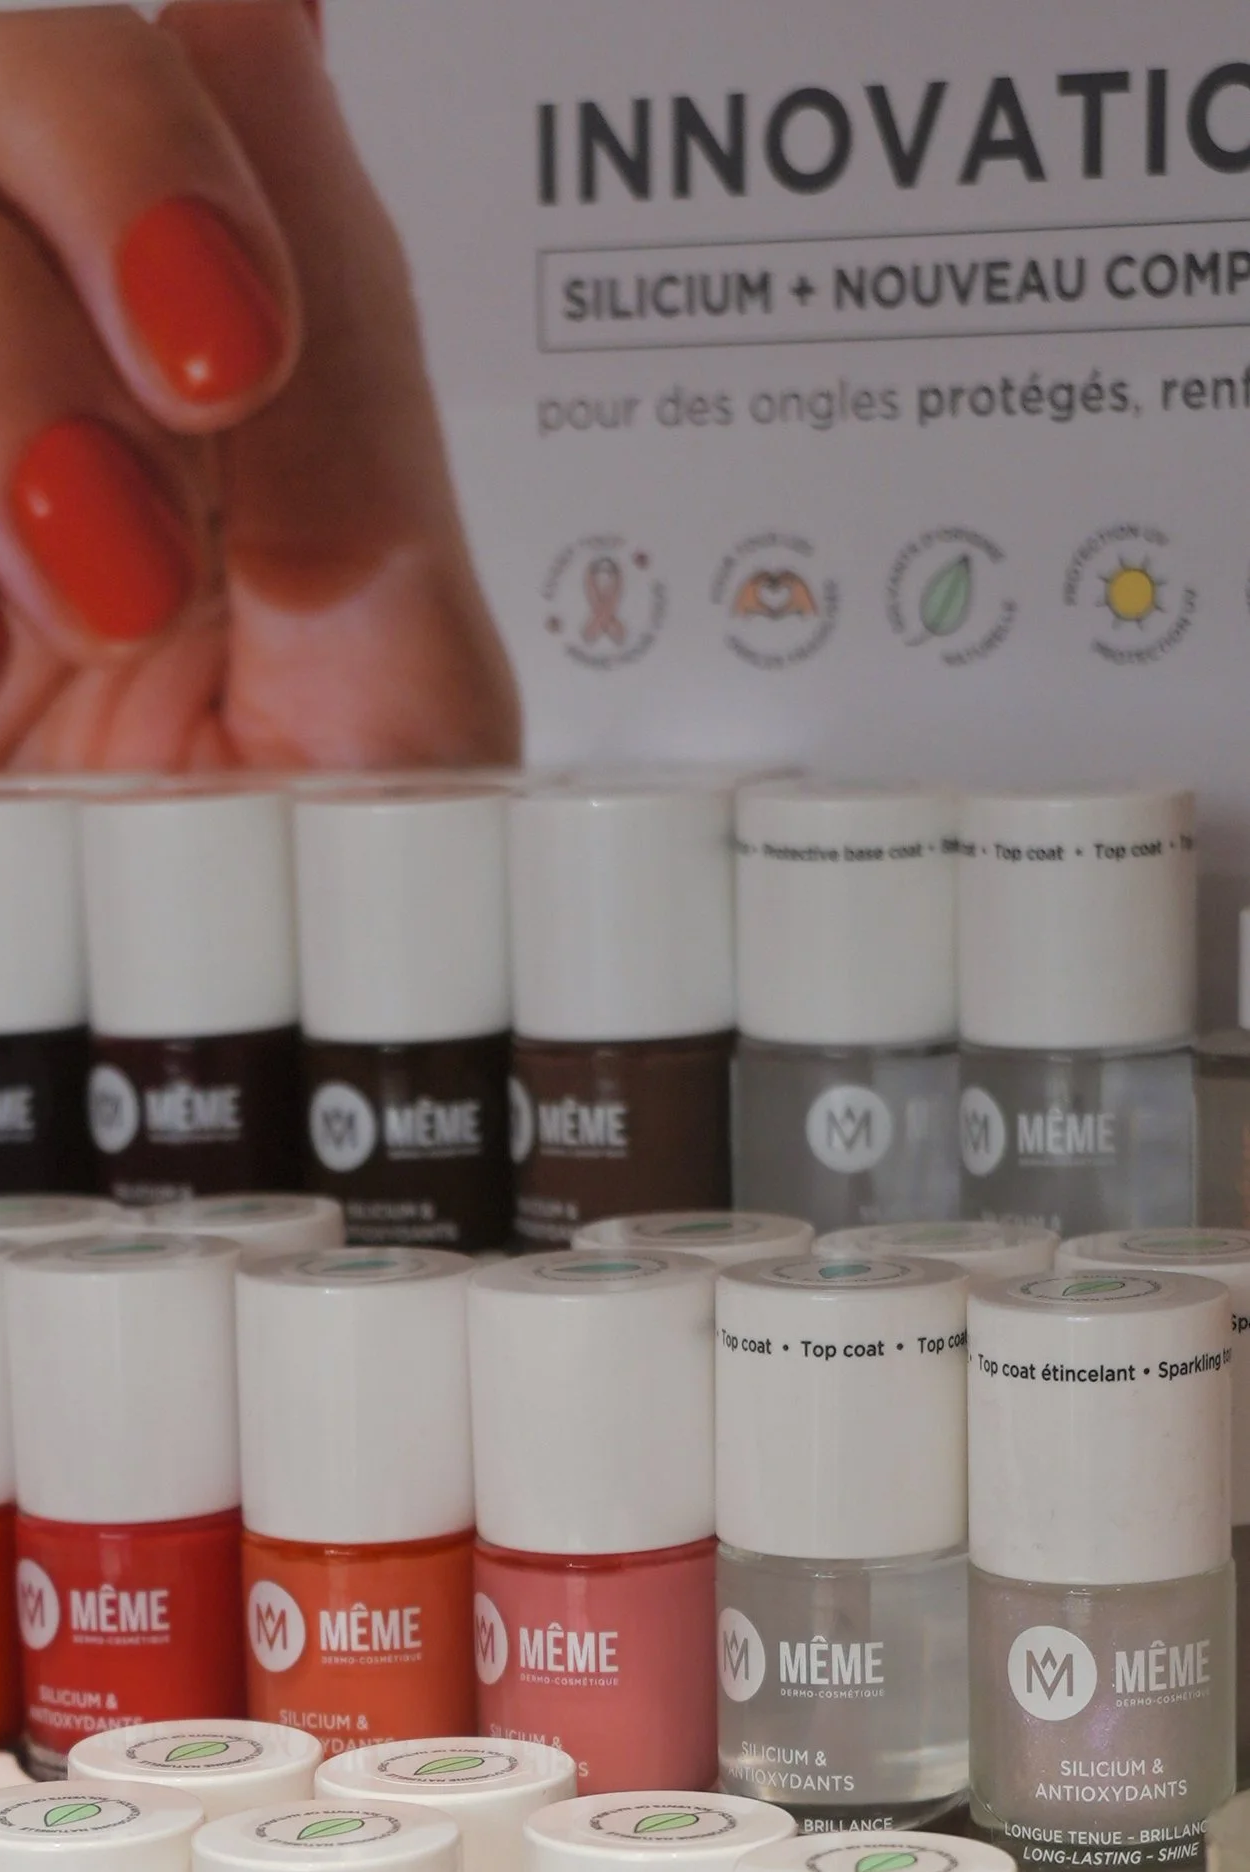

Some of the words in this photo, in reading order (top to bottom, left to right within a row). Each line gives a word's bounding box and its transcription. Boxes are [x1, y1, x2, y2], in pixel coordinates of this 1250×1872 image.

[537, 60, 1250, 206] INNOVATIO
[562, 270, 774, 323] SILICIUM
[832, 257, 1086, 311] NOUVEAU
[1105, 250, 1250, 300] COMP
[538, 392, 639, 438] pour
[656, 383, 734, 430] des
[751, 378, 901, 431] ongles
[917, 369, 1144, 427] protégés,
[844, 845, 885, 863] base
[889, 843, 924, 859] coat
[994, 844, 1022, 863] Top
[1027, 845, 1065, 862] coat
[1095, 843, 1126, 862] Top
[1131, 840, 1163, 858] coat
[1017, 1109, 1116, 1155] MÊME
[720, 1329, 739, 1353] Top
[741, 1336, 772, 1356] coat
[800, 1340, 837, 1361] Top
[843, 1339, 885, 1358] coat
[917, 1336, 945, 1357] Top
[978, 1353, 999, 1380] Top
[1001, 1361, 1036, 1380] coat
[1042, 1361, 1136, 1384] étincelant
[1158, 1351, 1222, 1381] Sparkling
[69, 1583, 171, 1633] MÊME
[319, 1602, 422, 1652] MÊME
[519, 1621, 619, 1674] MÊME
[779, 1634, 885, 1686] MÊME
[1114, 1639, 1211, 1695] MÊME
[279, 1708, 351, 1731] SILICIUM
[356, 1713, 369, 1731] &
[741, 1740, 809, 1766] SILICIUM
[814, 1751, 827, 1768] &
[1060, 1758, 1146, 1778] SILICIUM
[1152, 1758, 1164, 1775] &
[728, 1766, 855, 1792] ANTIOXYDANTS
[1035, 1779, 1188, 1803] ANTIOXYDANTS
[803, 1816, 893, 1833] BRILLANCE
[1004, 1821, 1063, 1844] LONGUE
[1068, 1830, 1123, 1845] TENUE
[1140, 1819, 1209, 1844] BRILLANC
[1022, 1846, 1142, 1865] LONG-LASTING
[1158, 1842, 1201, 1862] SHINE
